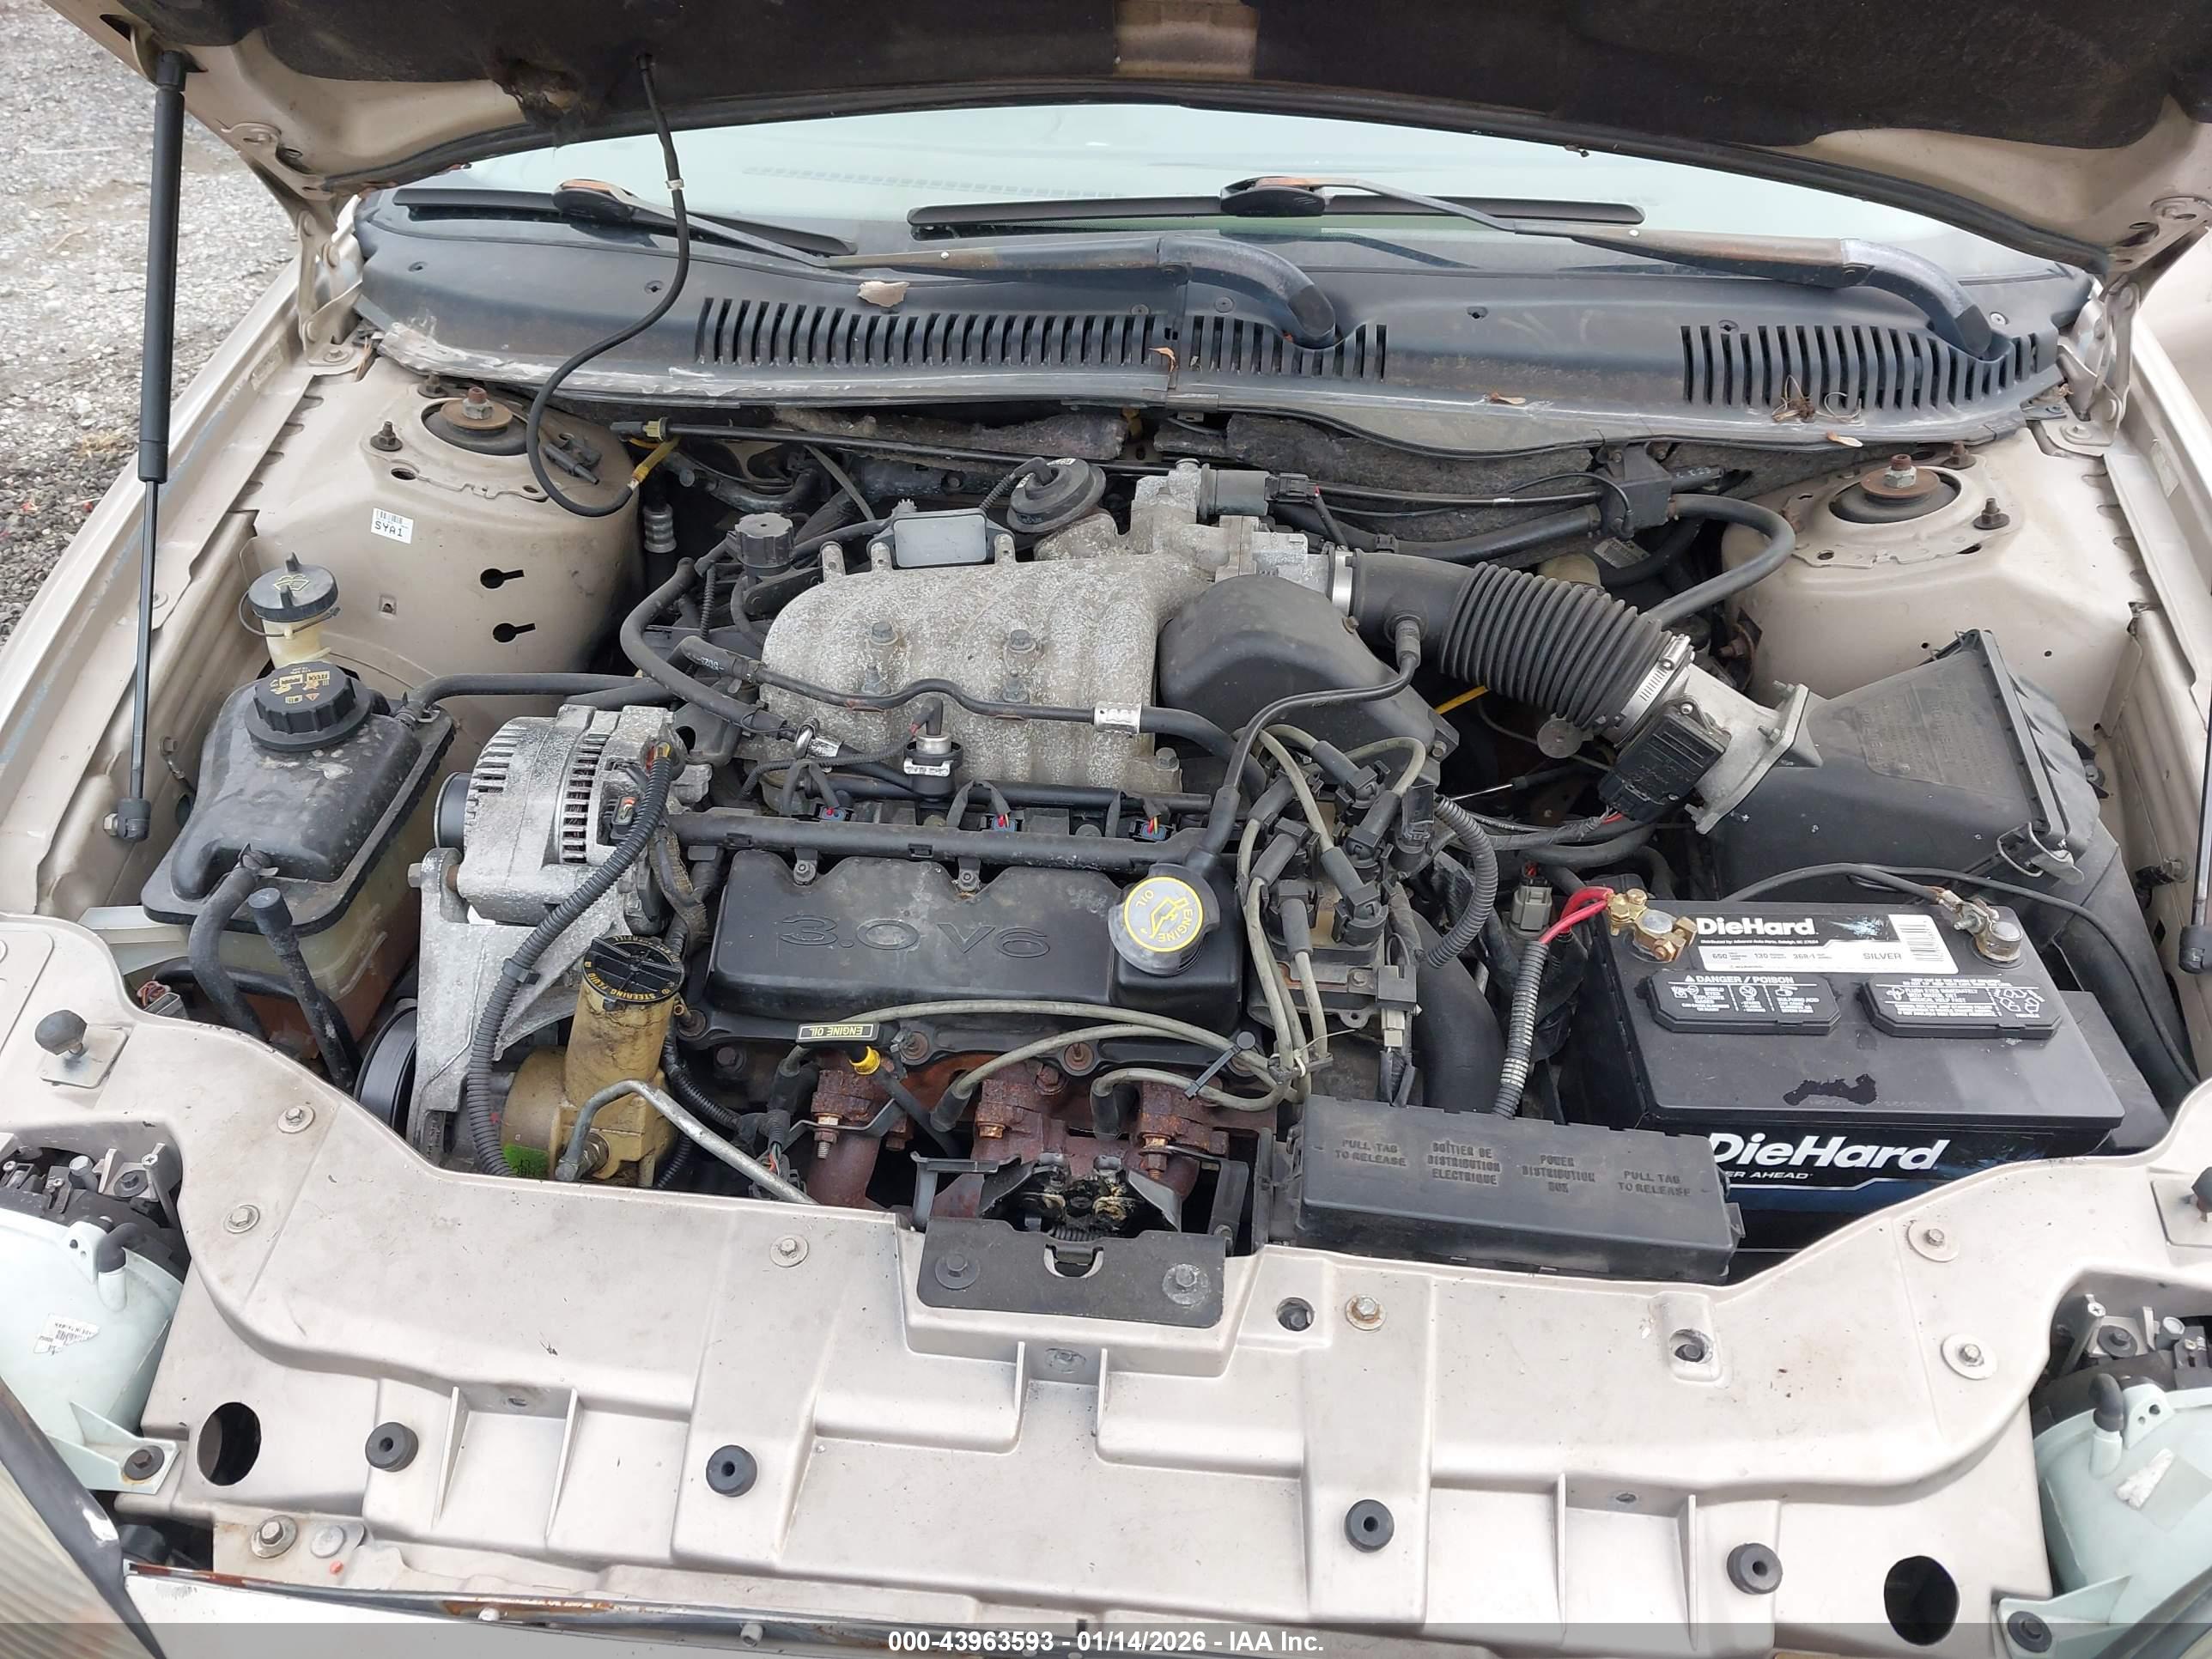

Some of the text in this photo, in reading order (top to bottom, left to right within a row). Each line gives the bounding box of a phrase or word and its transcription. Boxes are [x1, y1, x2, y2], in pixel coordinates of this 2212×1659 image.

[374, 520, 403, 538] SYA1
[1135, 889, 1193, 943] ENGINE OIL
[1696, 917, 1816, 935] DieHard
[779, 914, 1051, 959] 3.0 V6
[588, 972, 656, 1001] STEERING FLUID
[1753, 975, 1795, 984] POISON
[809, 1025, 863, 1037] ENGINE OIL
[1342, 1139, 1399, 1154] PULL TAG
[1708, 1132, 1950, 1170] DieHard
[1335, 1149, 1407, 1167] TO RELEASE
[1426, 1154, 1501, 1173] DISTRIBUTION
[1540, 1154, 1576, 1168] POWER
[1522, 1166, 1596, 1182] DISTRIBUTION
[1624, 1170, 1681, 1184] PULL TAG
[1749, 1170, 1809, 1180] AHEAD
[1548, 1182, 1570, 1194] BOX
[1618, 1182, 1692, 1197] TO RELEASE
